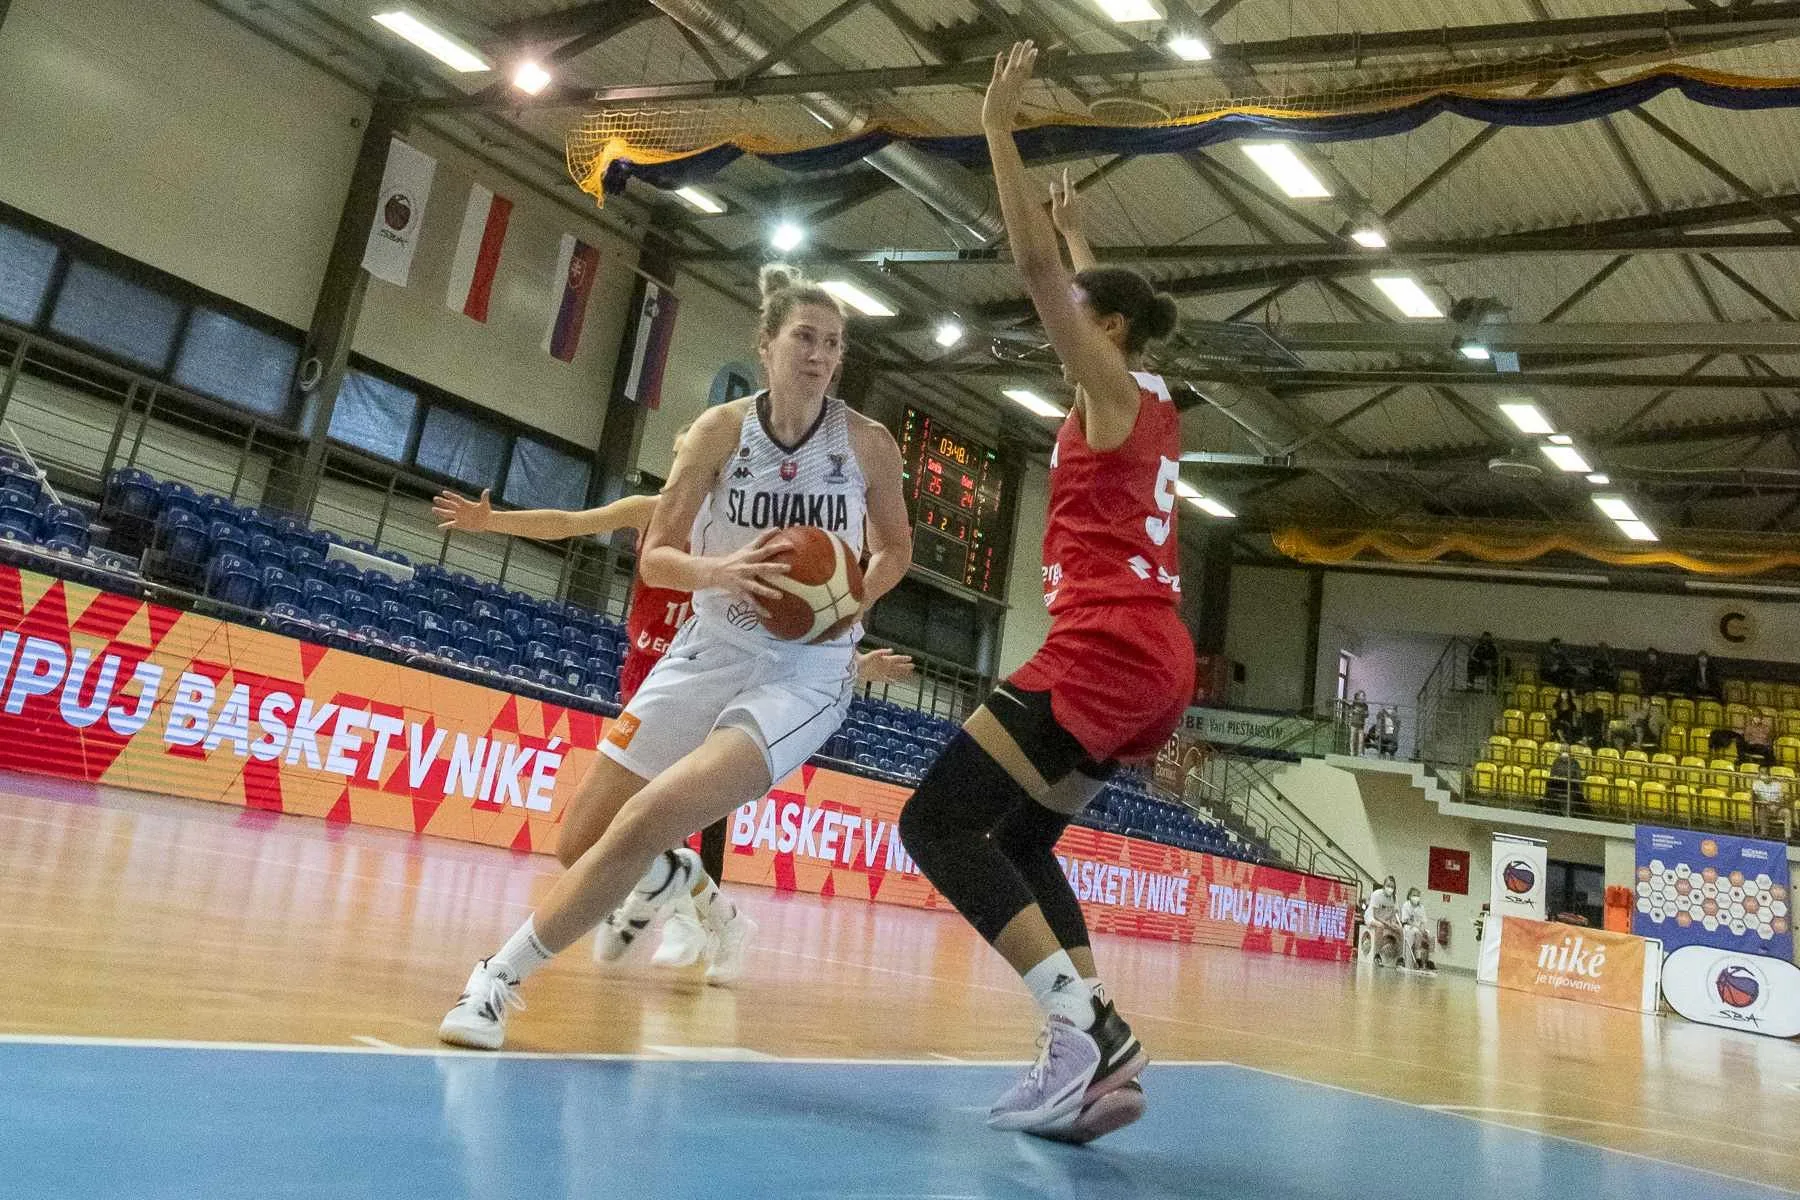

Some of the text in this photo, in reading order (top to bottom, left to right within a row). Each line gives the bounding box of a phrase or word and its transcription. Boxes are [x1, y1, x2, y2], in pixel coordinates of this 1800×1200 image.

[726, 488, 848, 531] SLOVAKIA
[941, 517, 948, 531] 2
[664, 601, 690, 629] 11
[1720, 612, 1746, 643] C
[164, 672, 404, 781] BASKET
[409, 722, 449, 789] V
[443, 736, 563, 813] NIKÉ
[731, 799, 862, 864] BASKET
[865, 819, 886, 868] V
[1133, 870, 1148, 909] V
[1147, 867, 1191, 916] NIKÉ
[1209, 884, 1252, 924] TIPUJ
[1254, 892, 1308, 933] BASKET
[1308, 902, 1319, 935] V
[1537, 935, 1606, 978] niké
[1717, 1009, 1764, 1030] SBA
